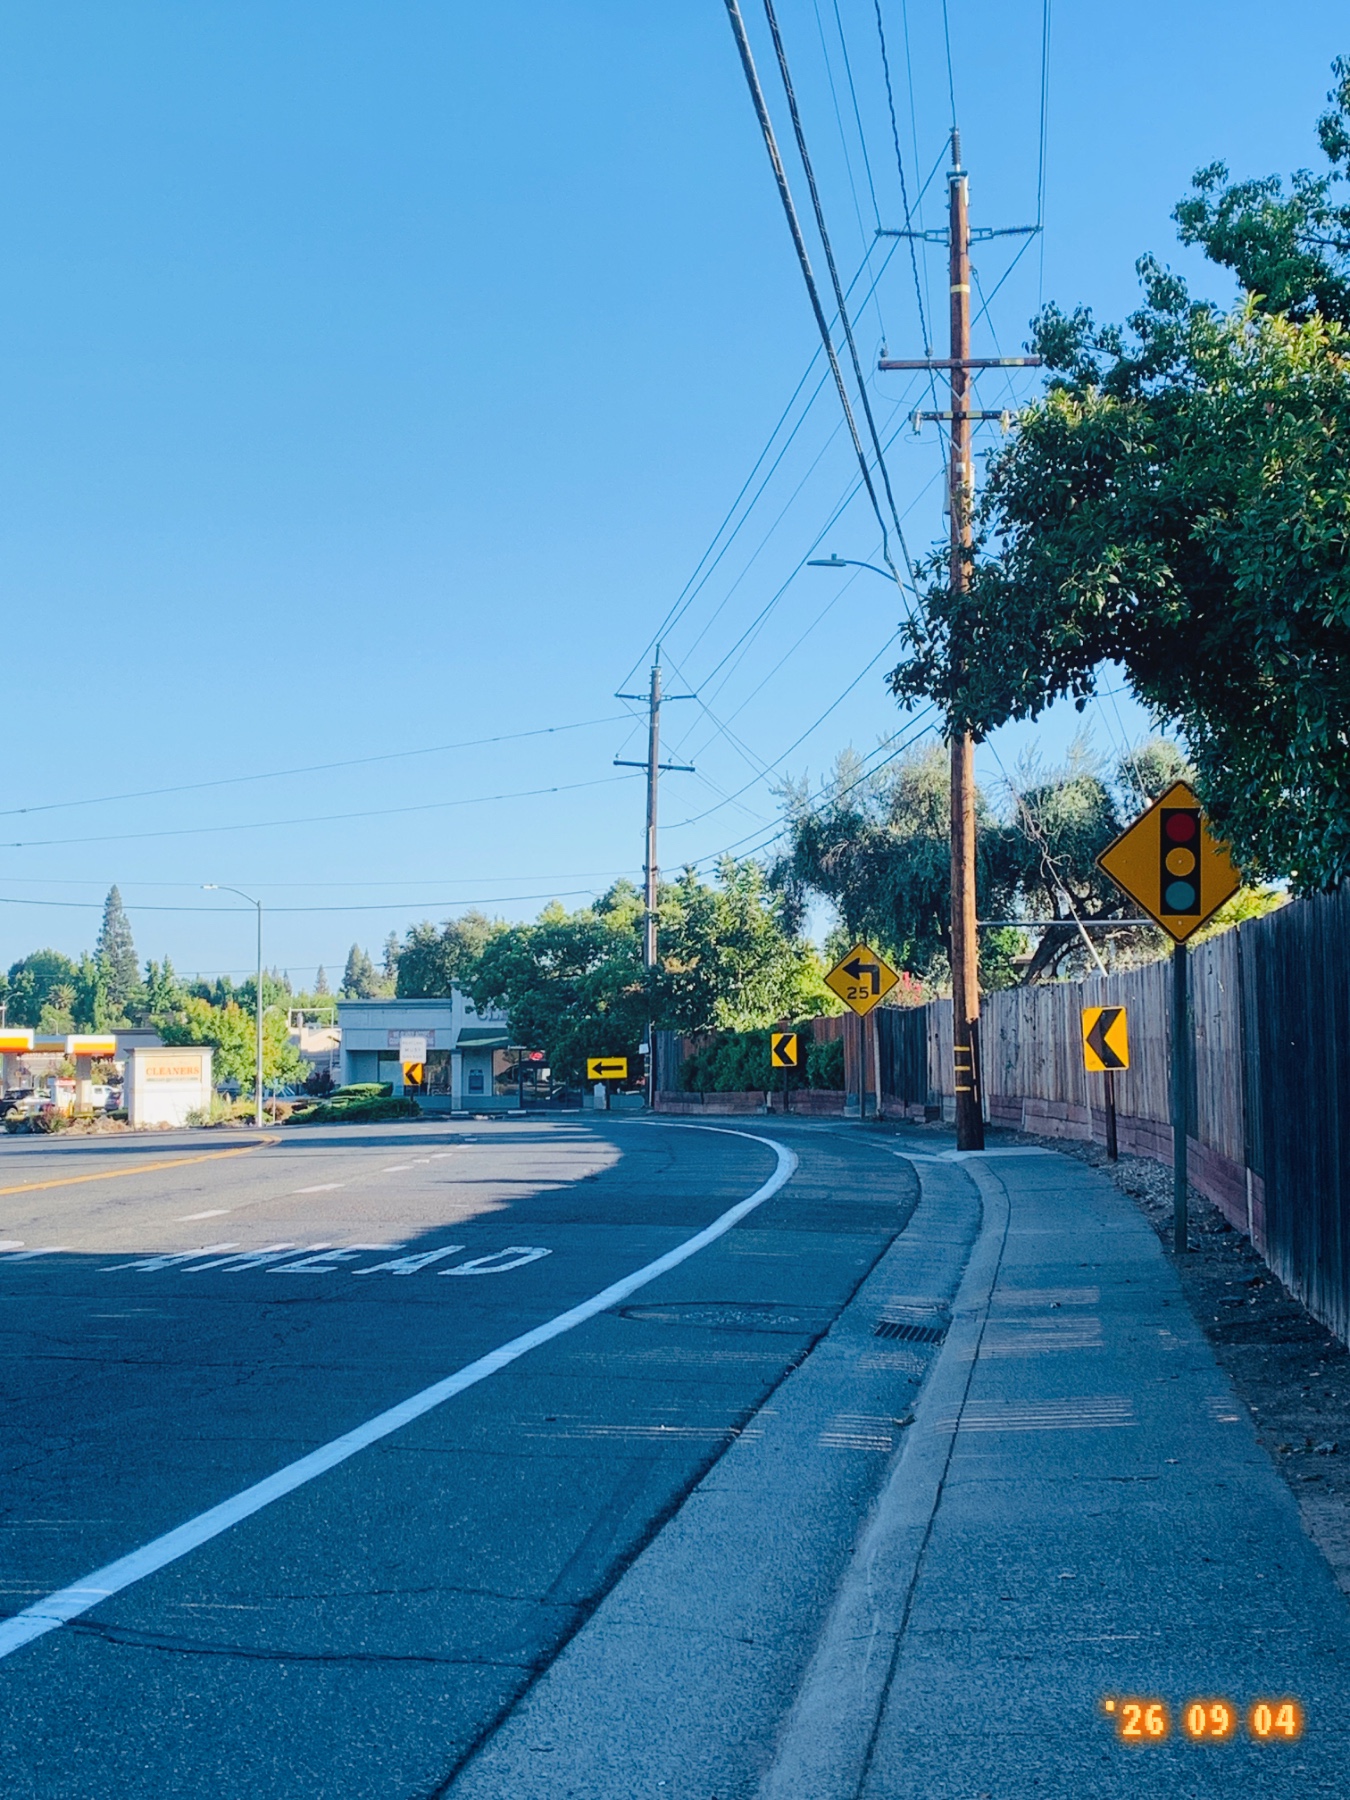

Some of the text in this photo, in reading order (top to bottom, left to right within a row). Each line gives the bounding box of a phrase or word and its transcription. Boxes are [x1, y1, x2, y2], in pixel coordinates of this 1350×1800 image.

[847, 987, 869, 999] 25
[146, 1067, 200, 1076] CLEANERS
[95, 1243, 554, 1275] AHEAD
